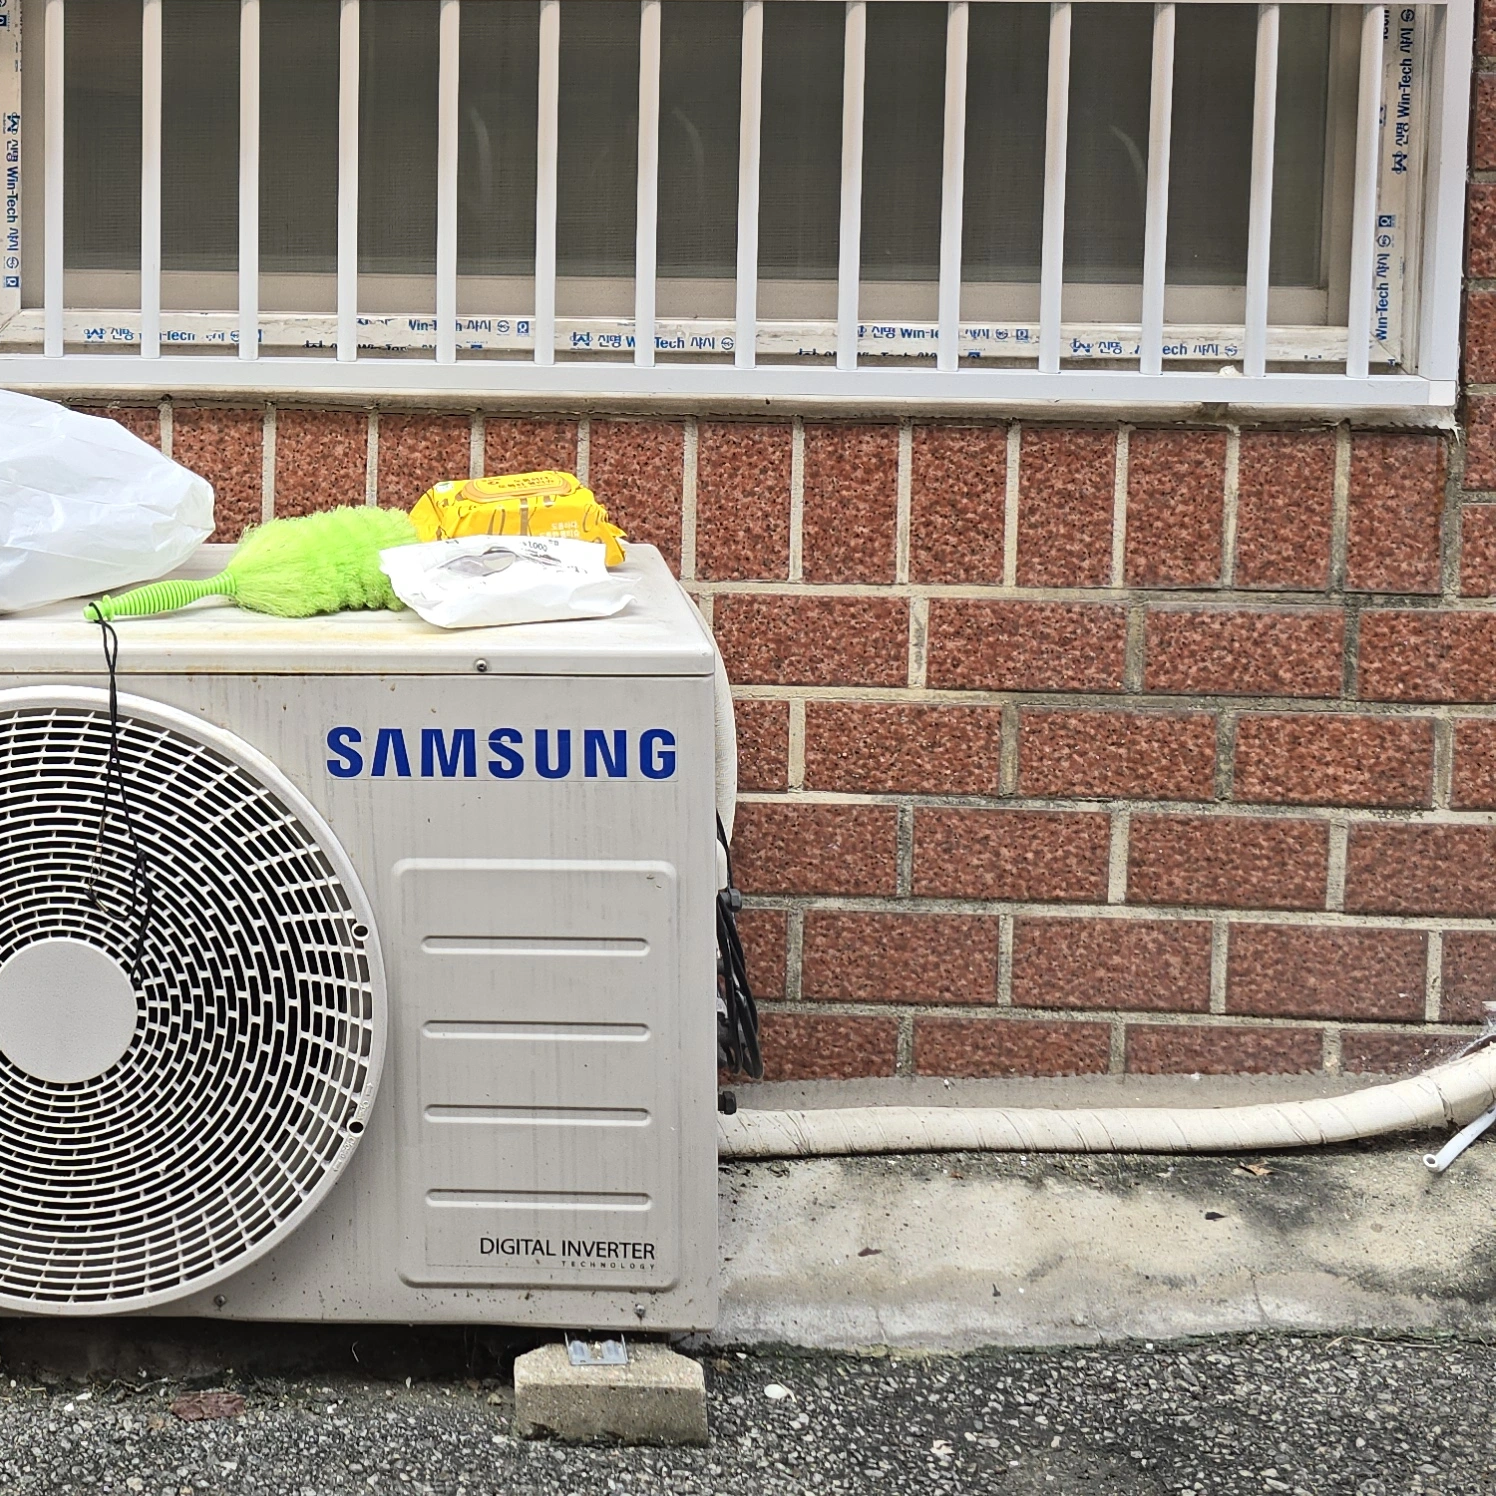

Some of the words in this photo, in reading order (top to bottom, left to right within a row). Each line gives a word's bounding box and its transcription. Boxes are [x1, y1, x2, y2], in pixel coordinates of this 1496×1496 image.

[1400, 27, 1414, 54] 샤시
[1397, 58, 1413, 119] Win-Tech
[1395, 122, 1409, 146] 신명
[6, 139, 19, 162] 신명
[7, 166, 19, 223] Win-Tech
[7, 227, 19, 251] 샤시
[1376, 253, 1391, 278] 샤시
[1375, 283, 1390, 341] Win-Tech
[597, 334, 622, 348] 신명
[690, 336, 715, 350] 샤시
[326, 726, 676, 779] SAMSUNG
[479, 1237, 556, 1257] DIGITAL
[561, 1239, 656, 1260] INVERTER
[561, 1260, 656, 1270] TECHNOLOGY
